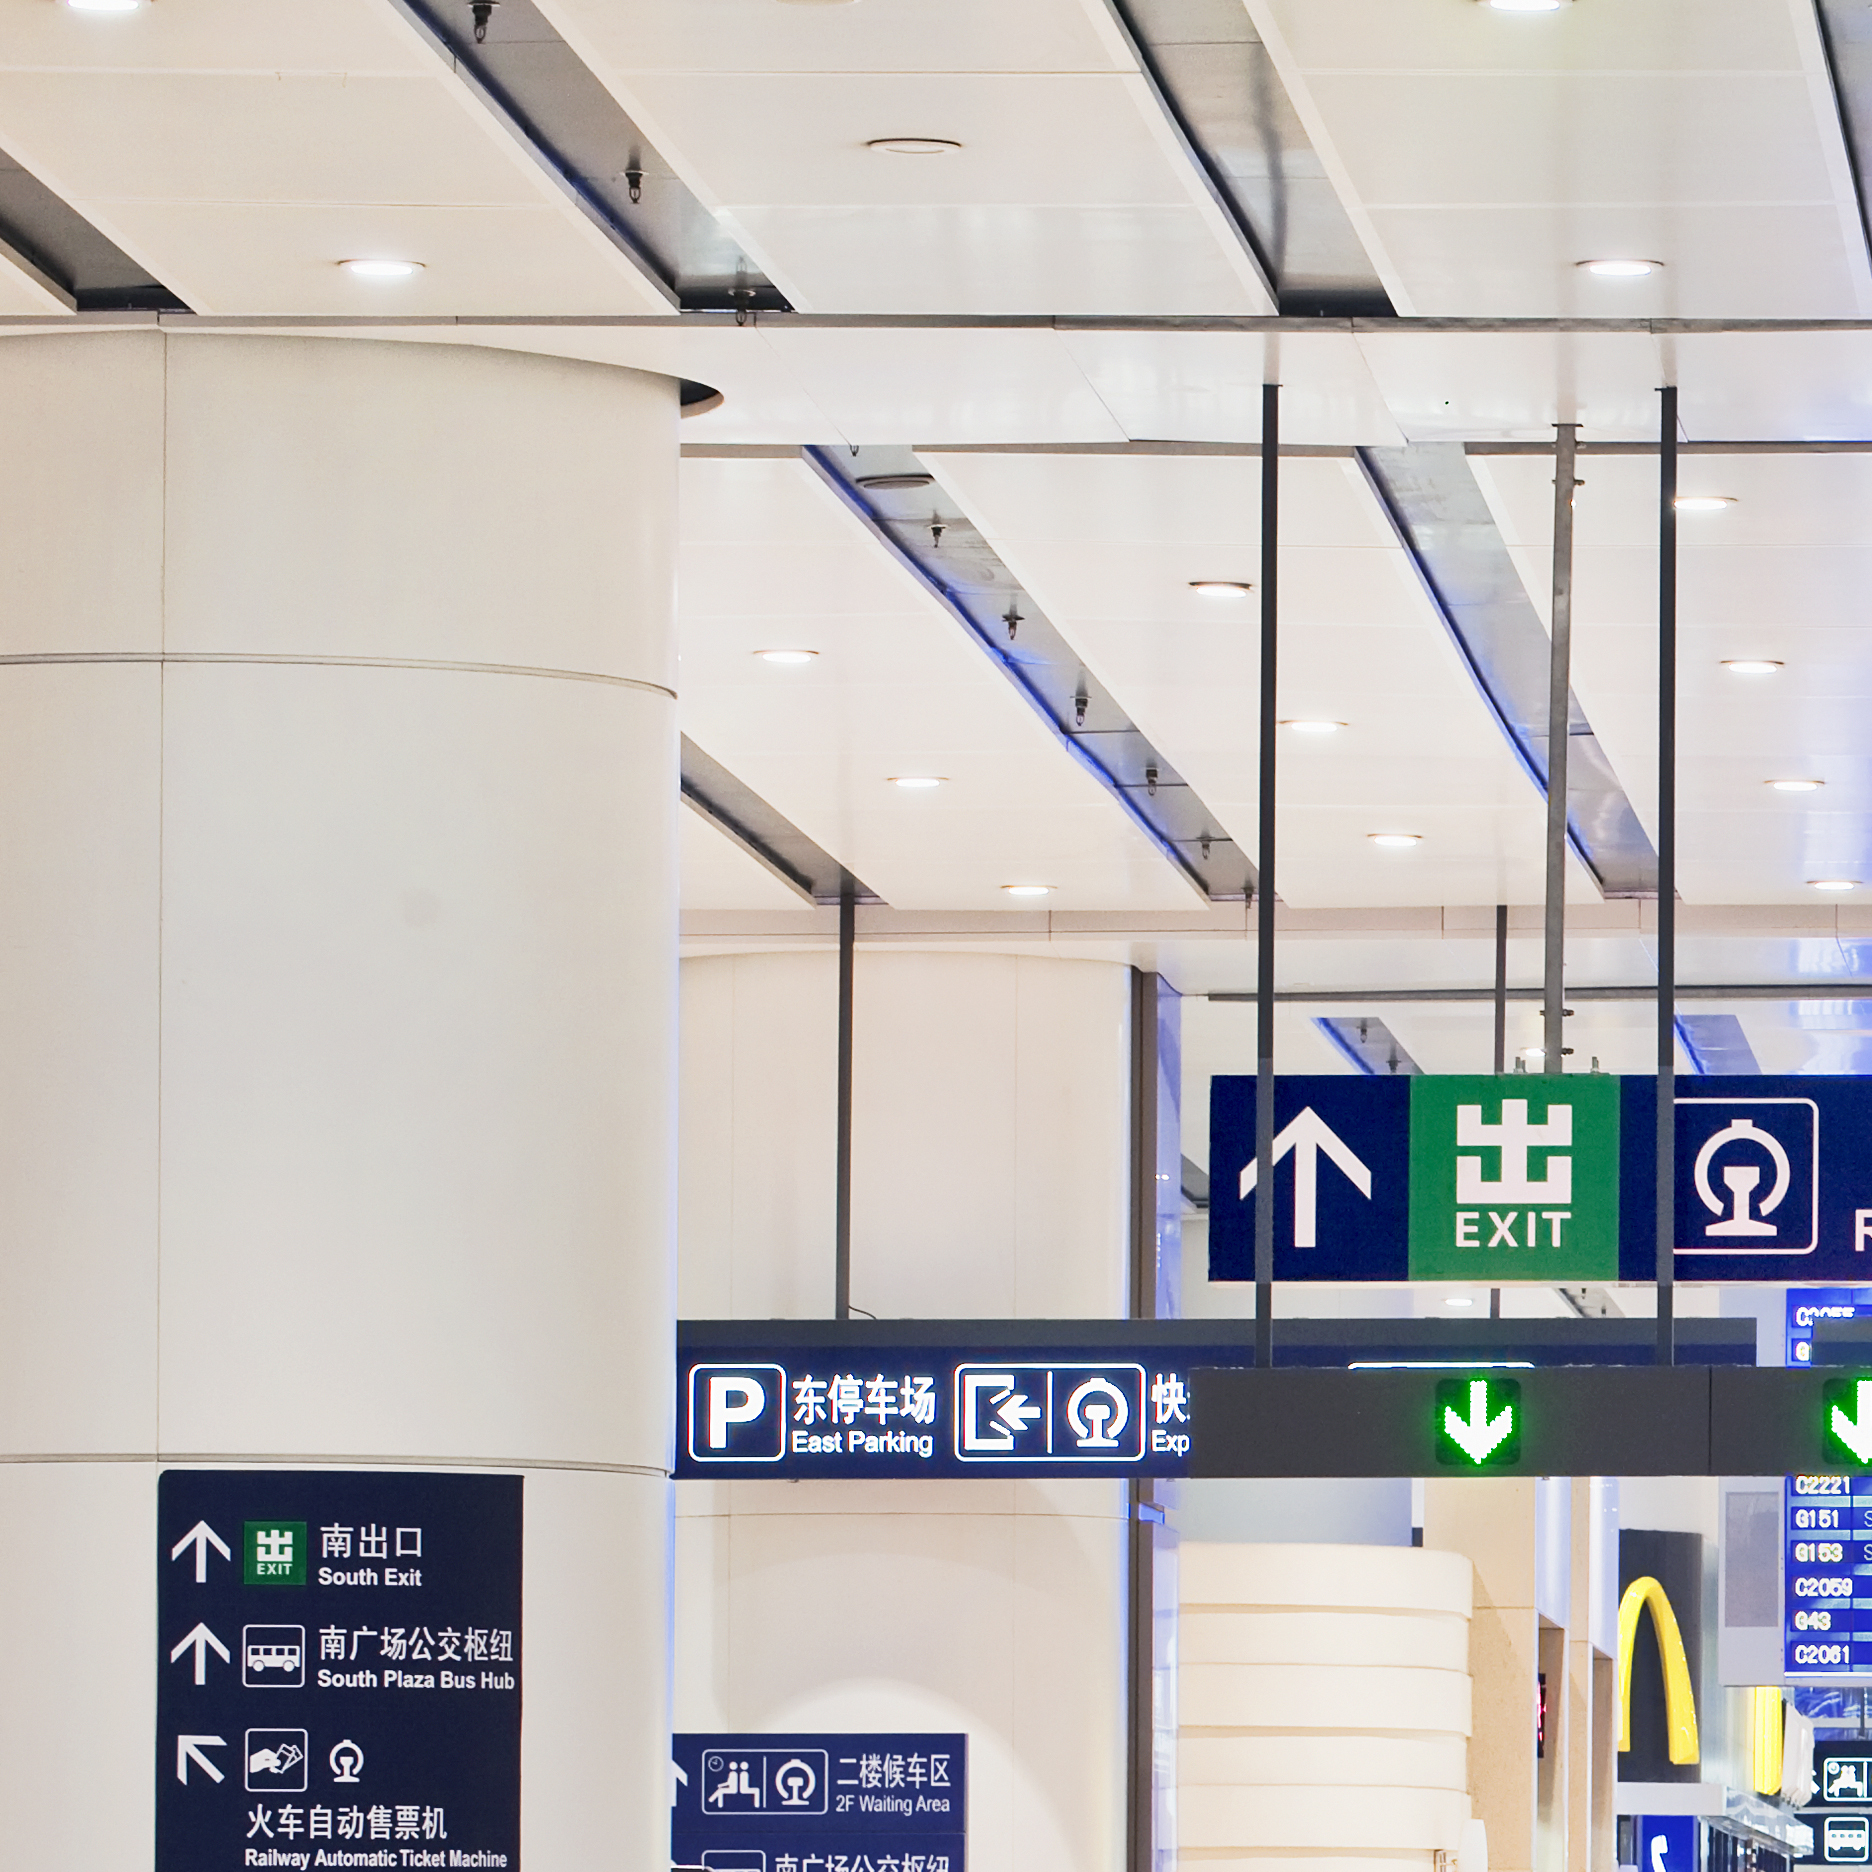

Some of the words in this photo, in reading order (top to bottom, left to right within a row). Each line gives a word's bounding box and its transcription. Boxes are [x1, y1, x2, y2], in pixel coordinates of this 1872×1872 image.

[1456, 1212, 1571, 1247] EXIT
[793, 1374, 935, 1425] 东停车场
[1151, 1373, 1187, 1424] 快
[792, 1430, 842, 1453] East
[849, 1431, 933, 1457] Parking
[1796, 1509, 1839, 1528] G151
[320, 1523, 421, 1559] 南出口
[1795, 1543, 1843, 1562] G153
[257, 1563, 292, 1574] EXIT
[318, 1567, 378, 1585] South
[385, 1568, 421, 1586] Exit
[1795, 1577, 1852, 1597] C2059
[1795, 1611, 1831, 1630] G43
[319, 1625, 513, 1662] 南广场公交枢纽
[318, 1669, 377, 1687] South
[384, 1670, 434, 1688] Plaza
[441, 1671, 476, 1688] Bus
[481, 1672, 514, 1689] Hub
[837, 1753, 950, 1789] 二楼候车区
[836, 1795, 854, 1812] 2F
[859, 1795, 912, 1816] Waiting
[916, 1795, 950, 1812] Area
[247, 1804, 447, 1840] 火车自动售票机
[245, 1849, 310, 1871] Railway
[314, 1849, 397, 1867] Automatic
[399, 1849, 445, 1867] Ticket
[450, 1850, 507, 1867] Machine
